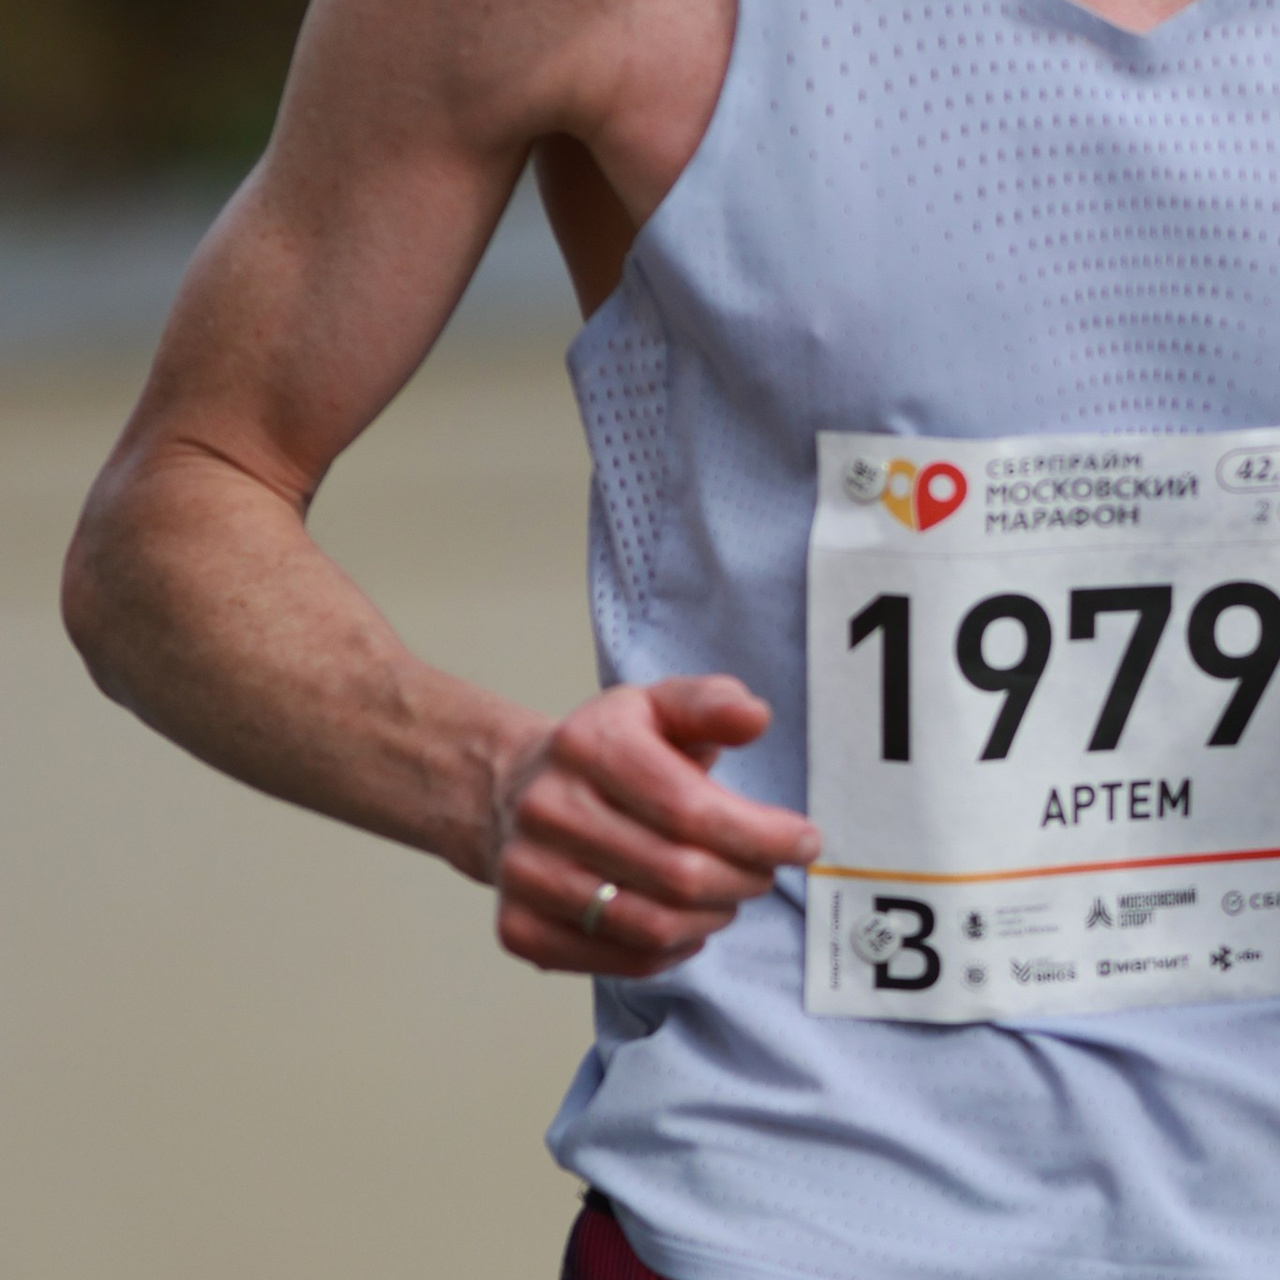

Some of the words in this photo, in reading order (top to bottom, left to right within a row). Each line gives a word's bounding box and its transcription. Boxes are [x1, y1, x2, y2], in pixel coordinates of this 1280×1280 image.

[985, 450, 1143, 479] СБЕРПРАЙМ
[985, 472, 1199, 506] МОСКОВСКИЙ
[985, 504, 1140, 535] МАРАФОН
[1041, 777, 1192, 827] АРТЕМ
